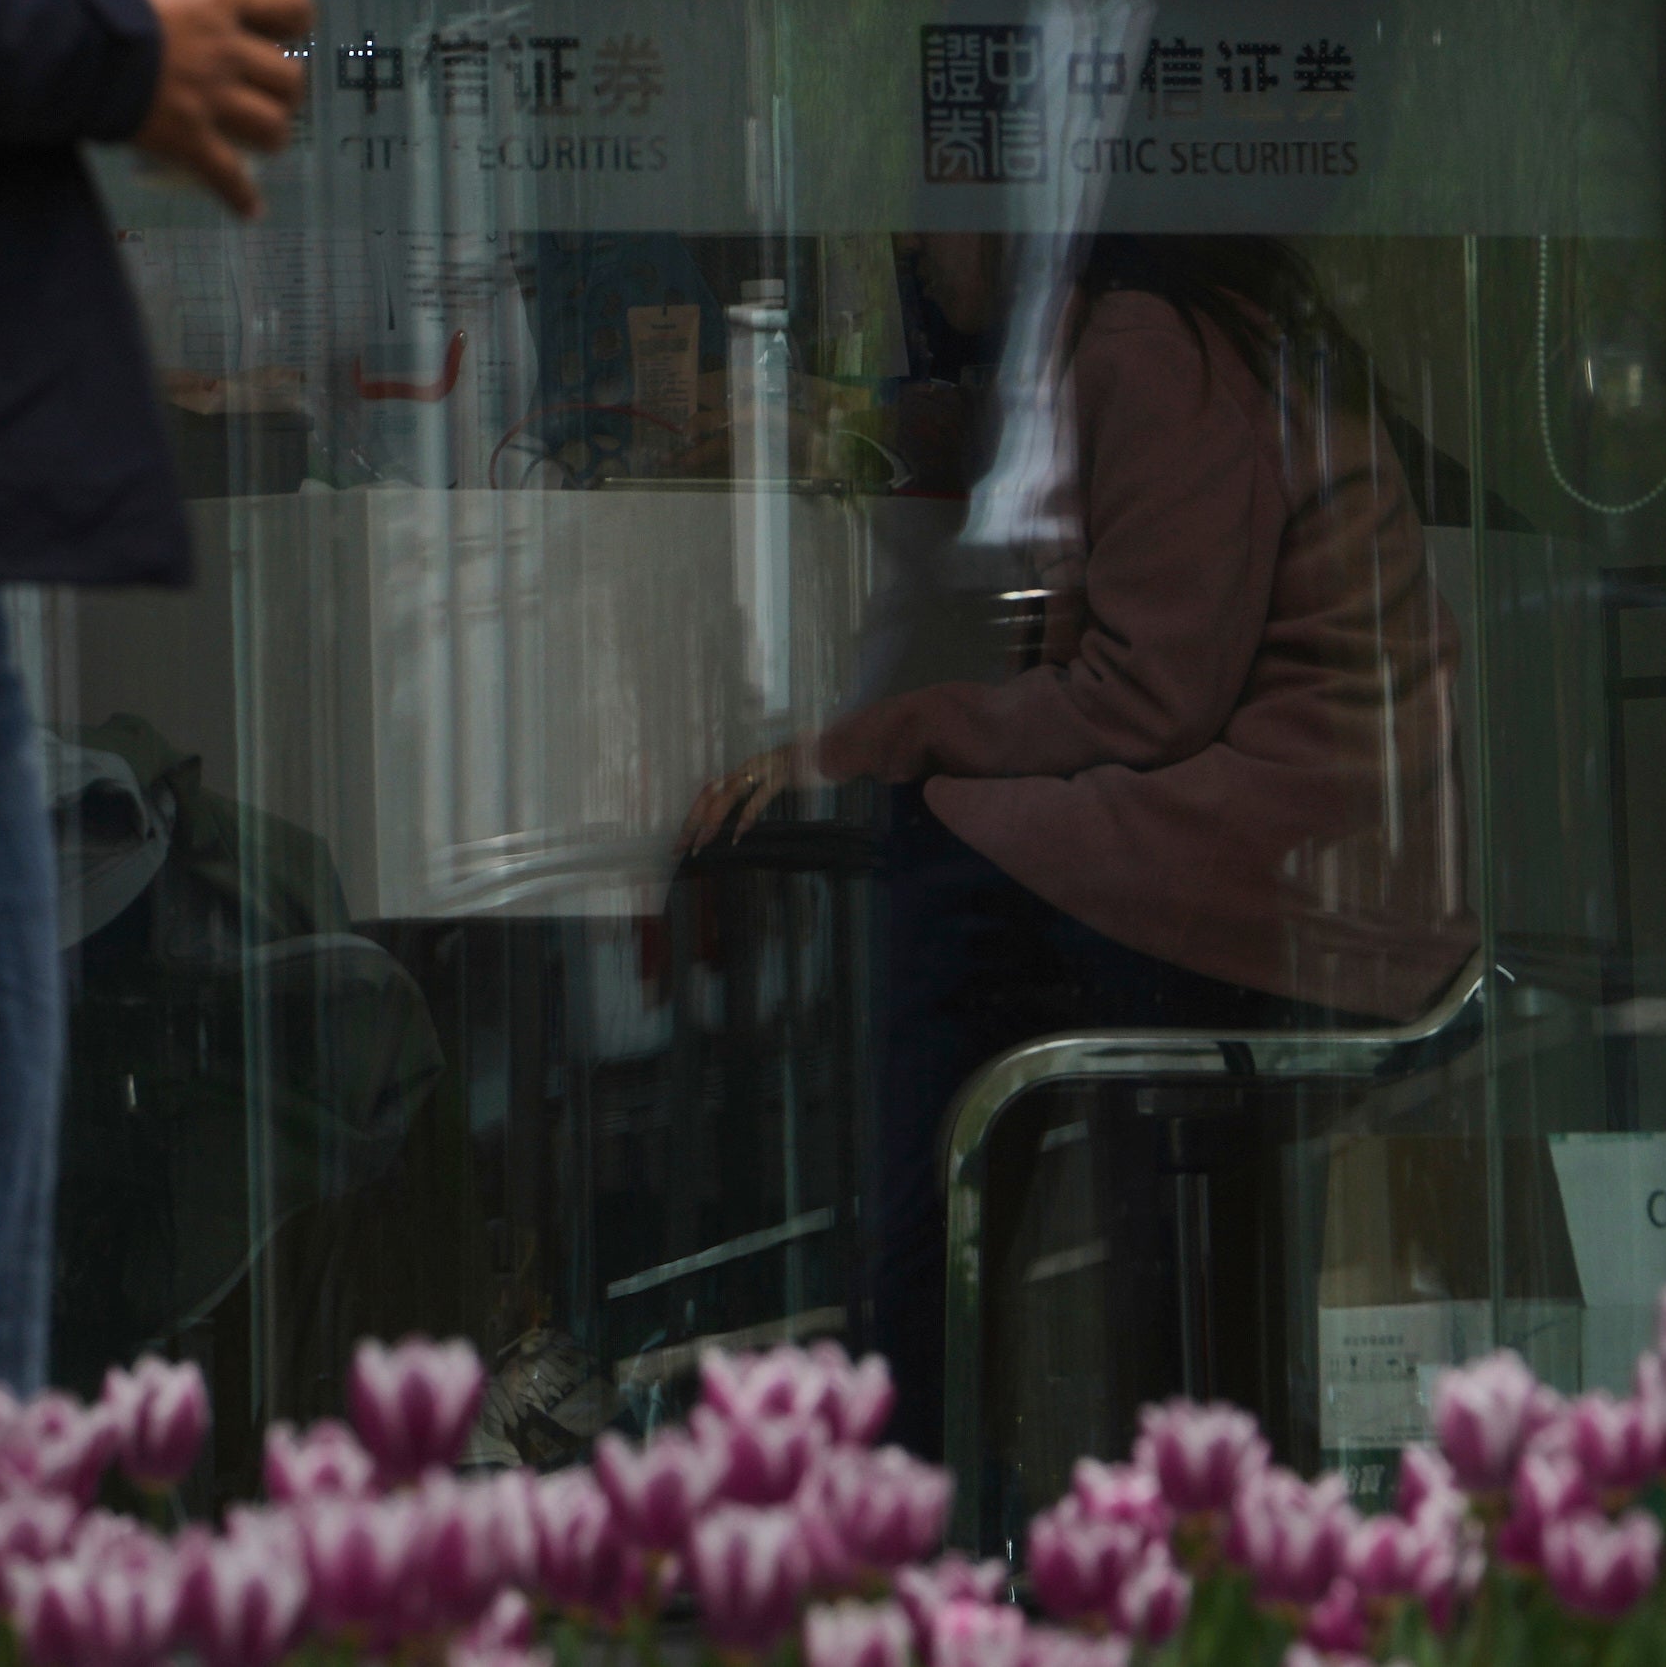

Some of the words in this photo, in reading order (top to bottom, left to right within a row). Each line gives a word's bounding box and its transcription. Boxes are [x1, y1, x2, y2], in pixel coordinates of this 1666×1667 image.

[337, 29, 664, 118] 中信证券
[1066, 36, 1358, 118] 中信证券
[1071, 136, 1158, 176] CITIC
[1169, 139, 1360, 177] SECURITIES
